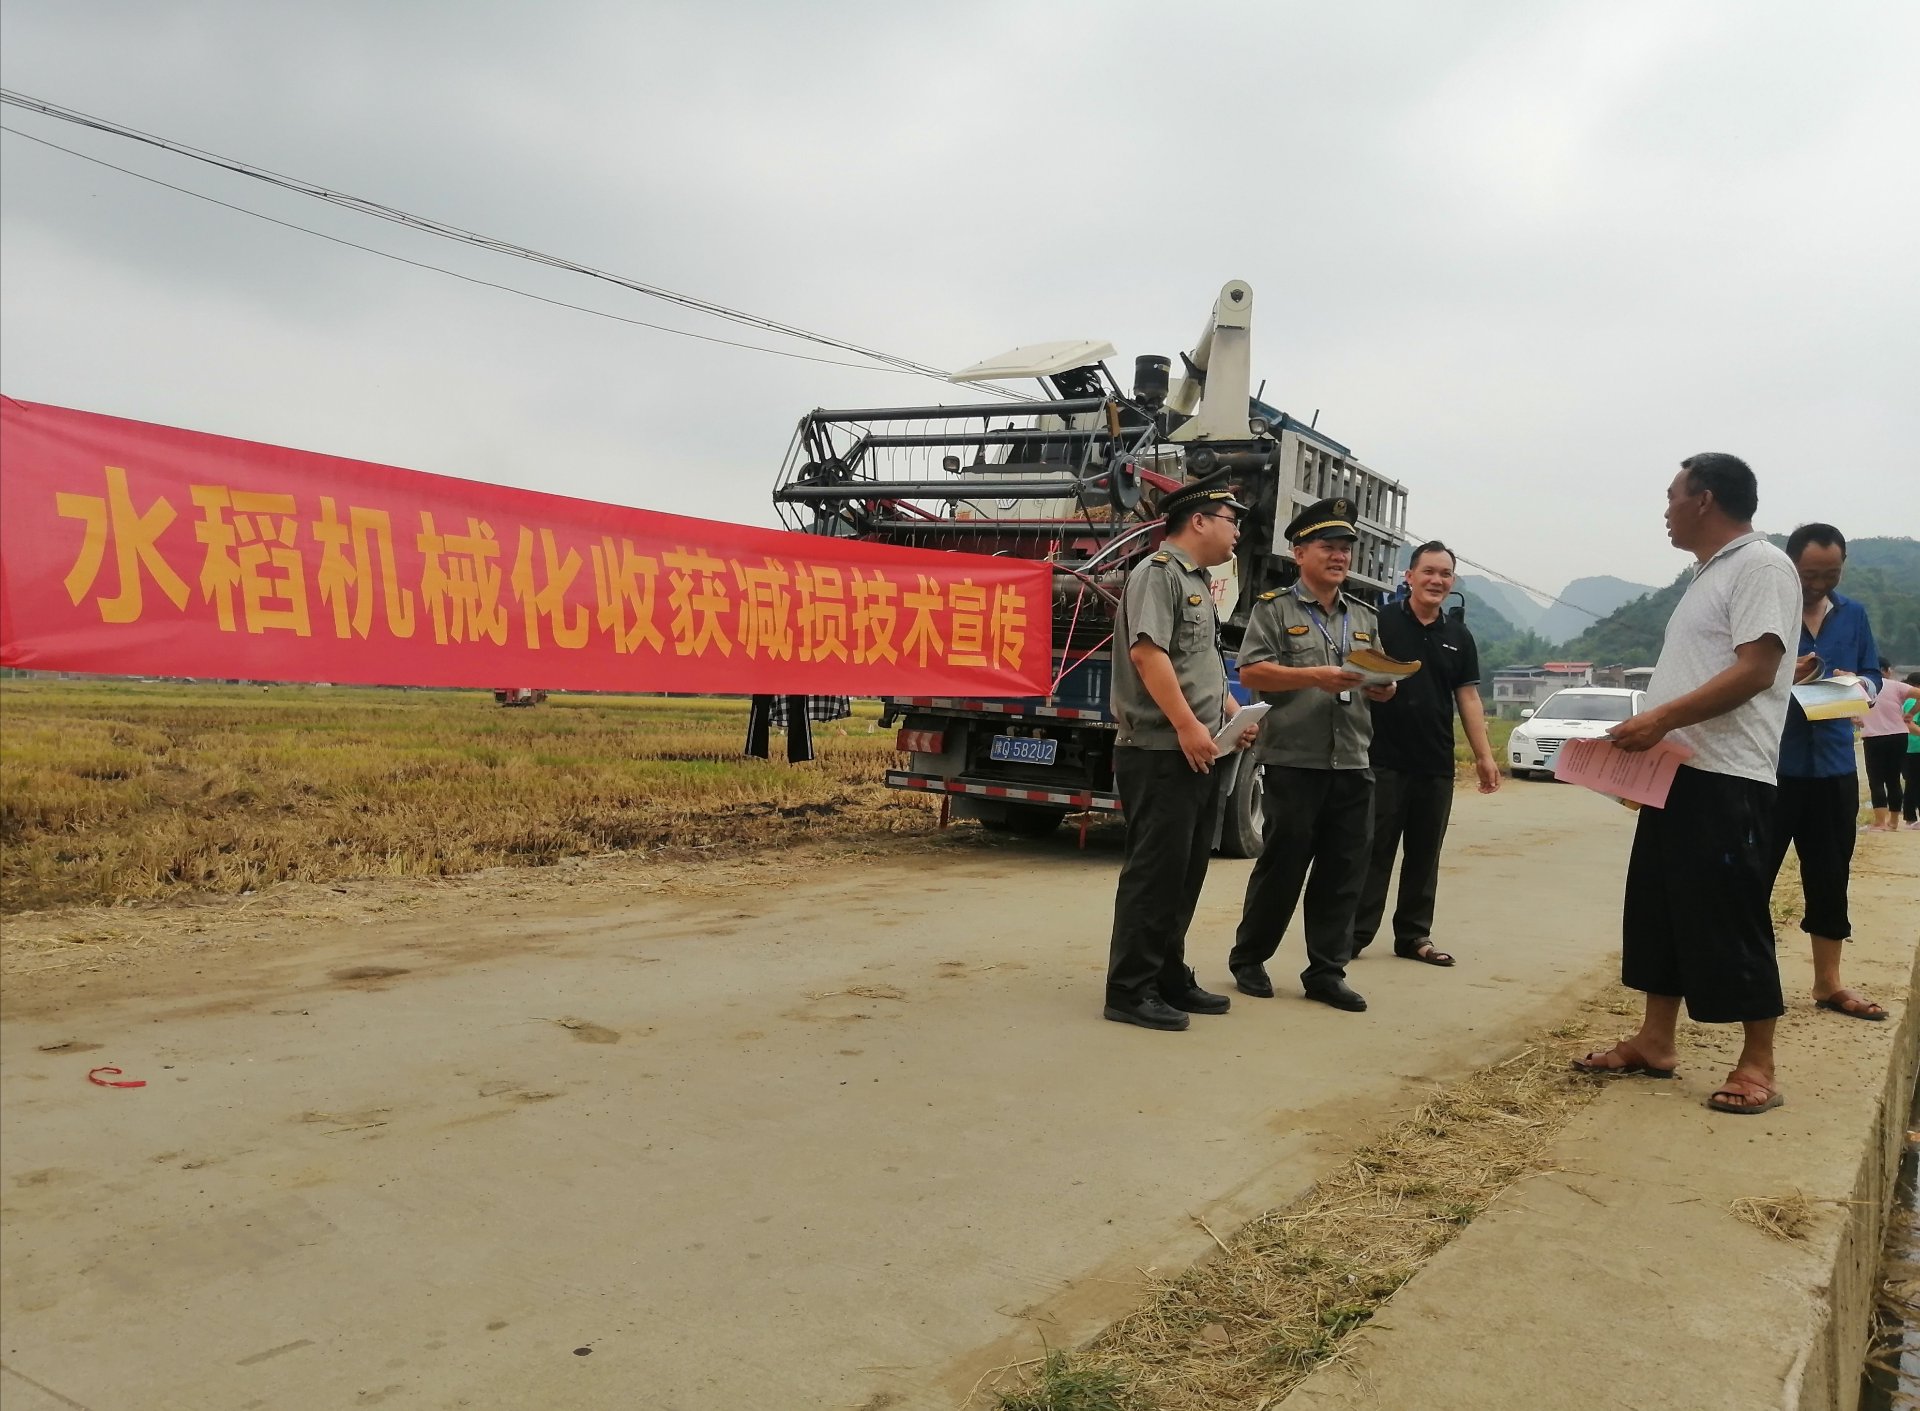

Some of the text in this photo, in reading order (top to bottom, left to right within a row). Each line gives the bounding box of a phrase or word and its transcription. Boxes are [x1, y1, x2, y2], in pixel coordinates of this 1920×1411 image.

[56, 466, 1026, 672] 水稻机械化收获减损技术宣传
